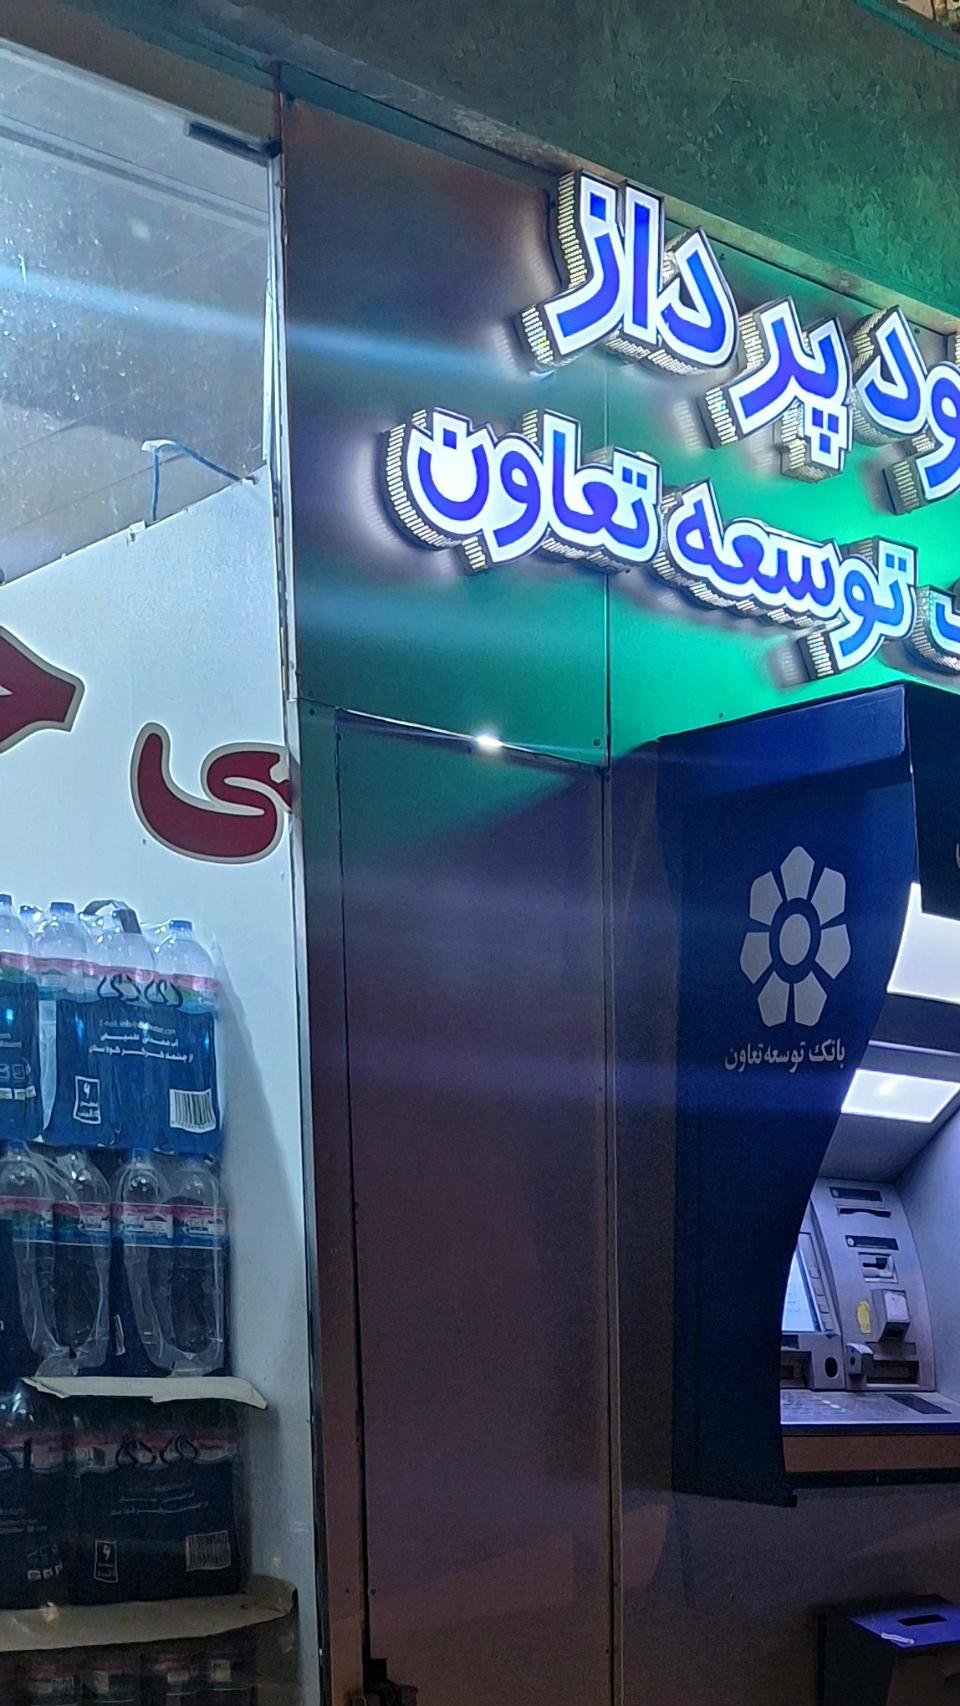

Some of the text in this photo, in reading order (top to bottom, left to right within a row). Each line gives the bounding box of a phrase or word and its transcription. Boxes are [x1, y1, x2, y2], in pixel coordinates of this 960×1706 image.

[406, 409, 661, 563] تعاون
[666, 481, 918, 673] توسعه
[724, 1038, 846, 1073] بانک توسعه تعاون
